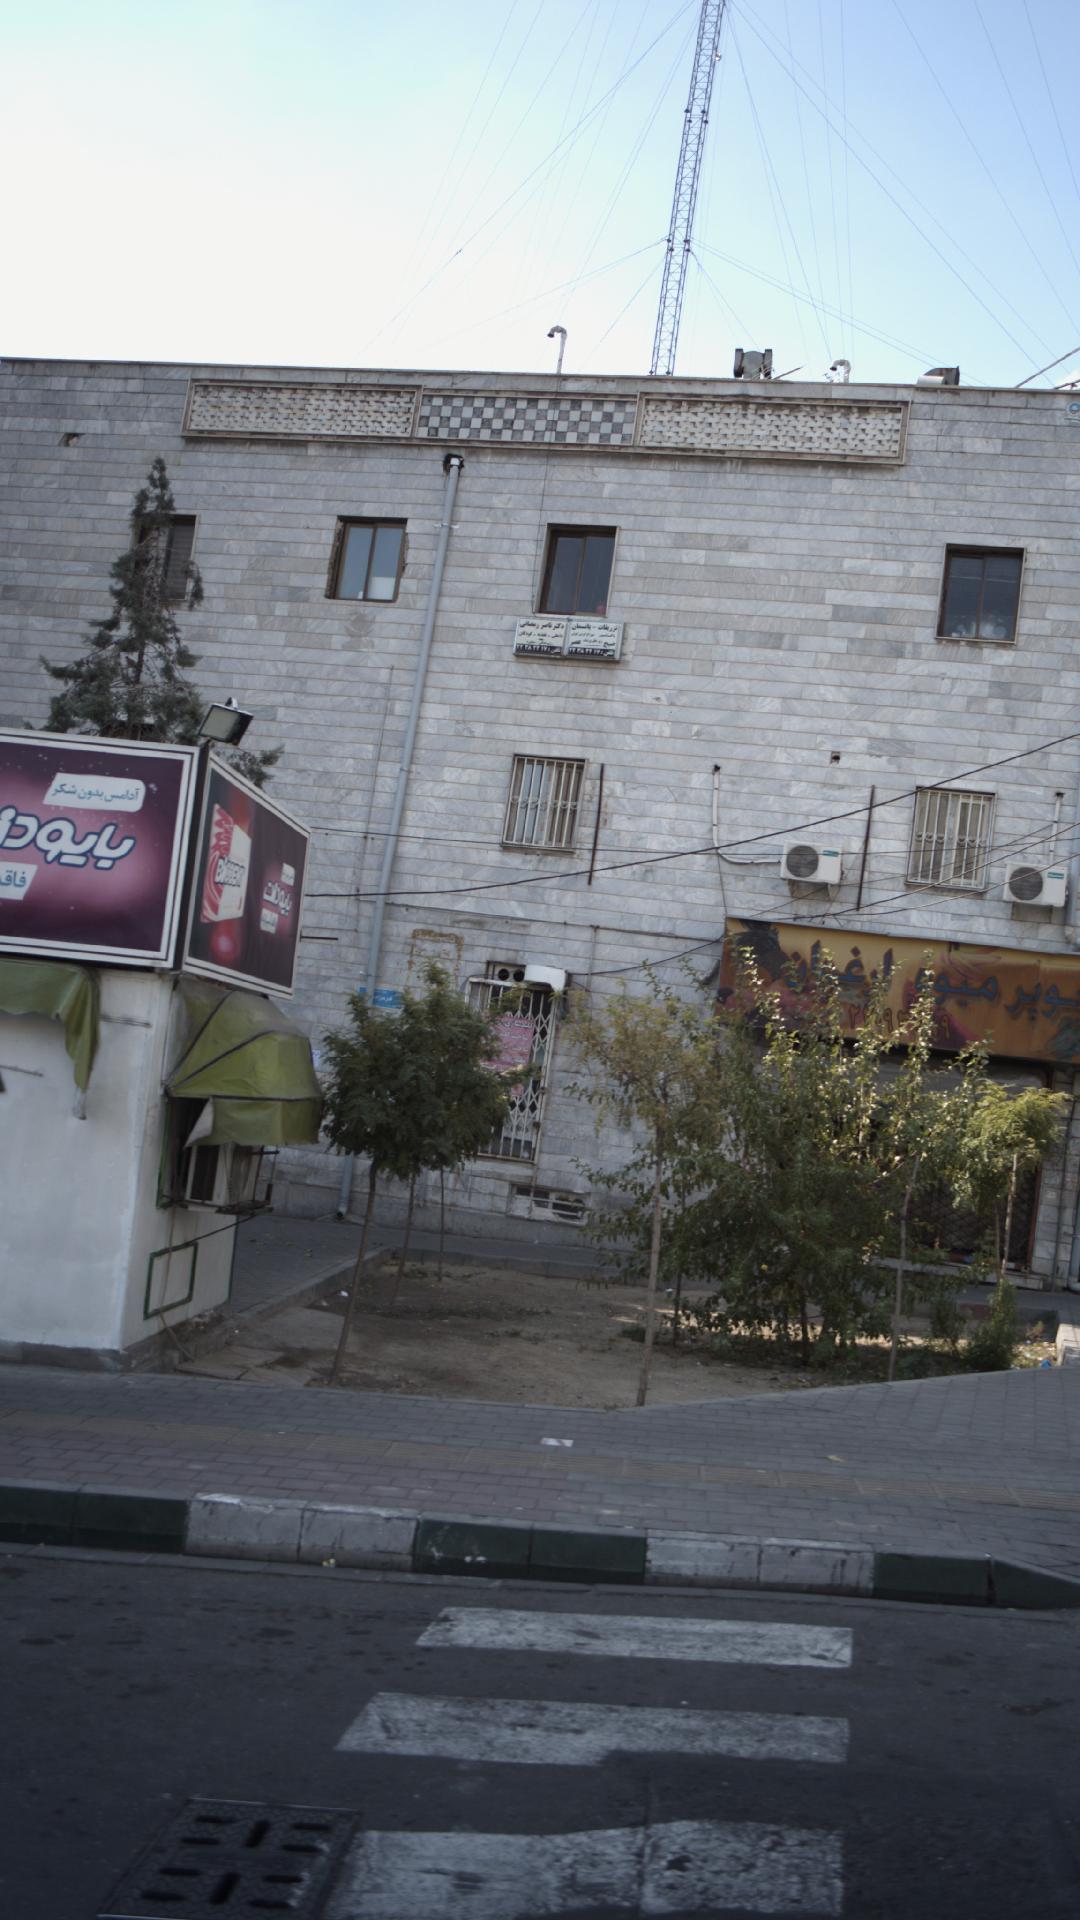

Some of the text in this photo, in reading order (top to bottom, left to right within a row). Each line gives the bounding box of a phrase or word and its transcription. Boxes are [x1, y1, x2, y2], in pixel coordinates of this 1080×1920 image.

[51, 782, 141, 803] آدامس بدون شکر
[0, 804, 137, 871] بایودن
[0, 869, 28, 888] فاق
[1005, 982, 1080, 1023] وپر
